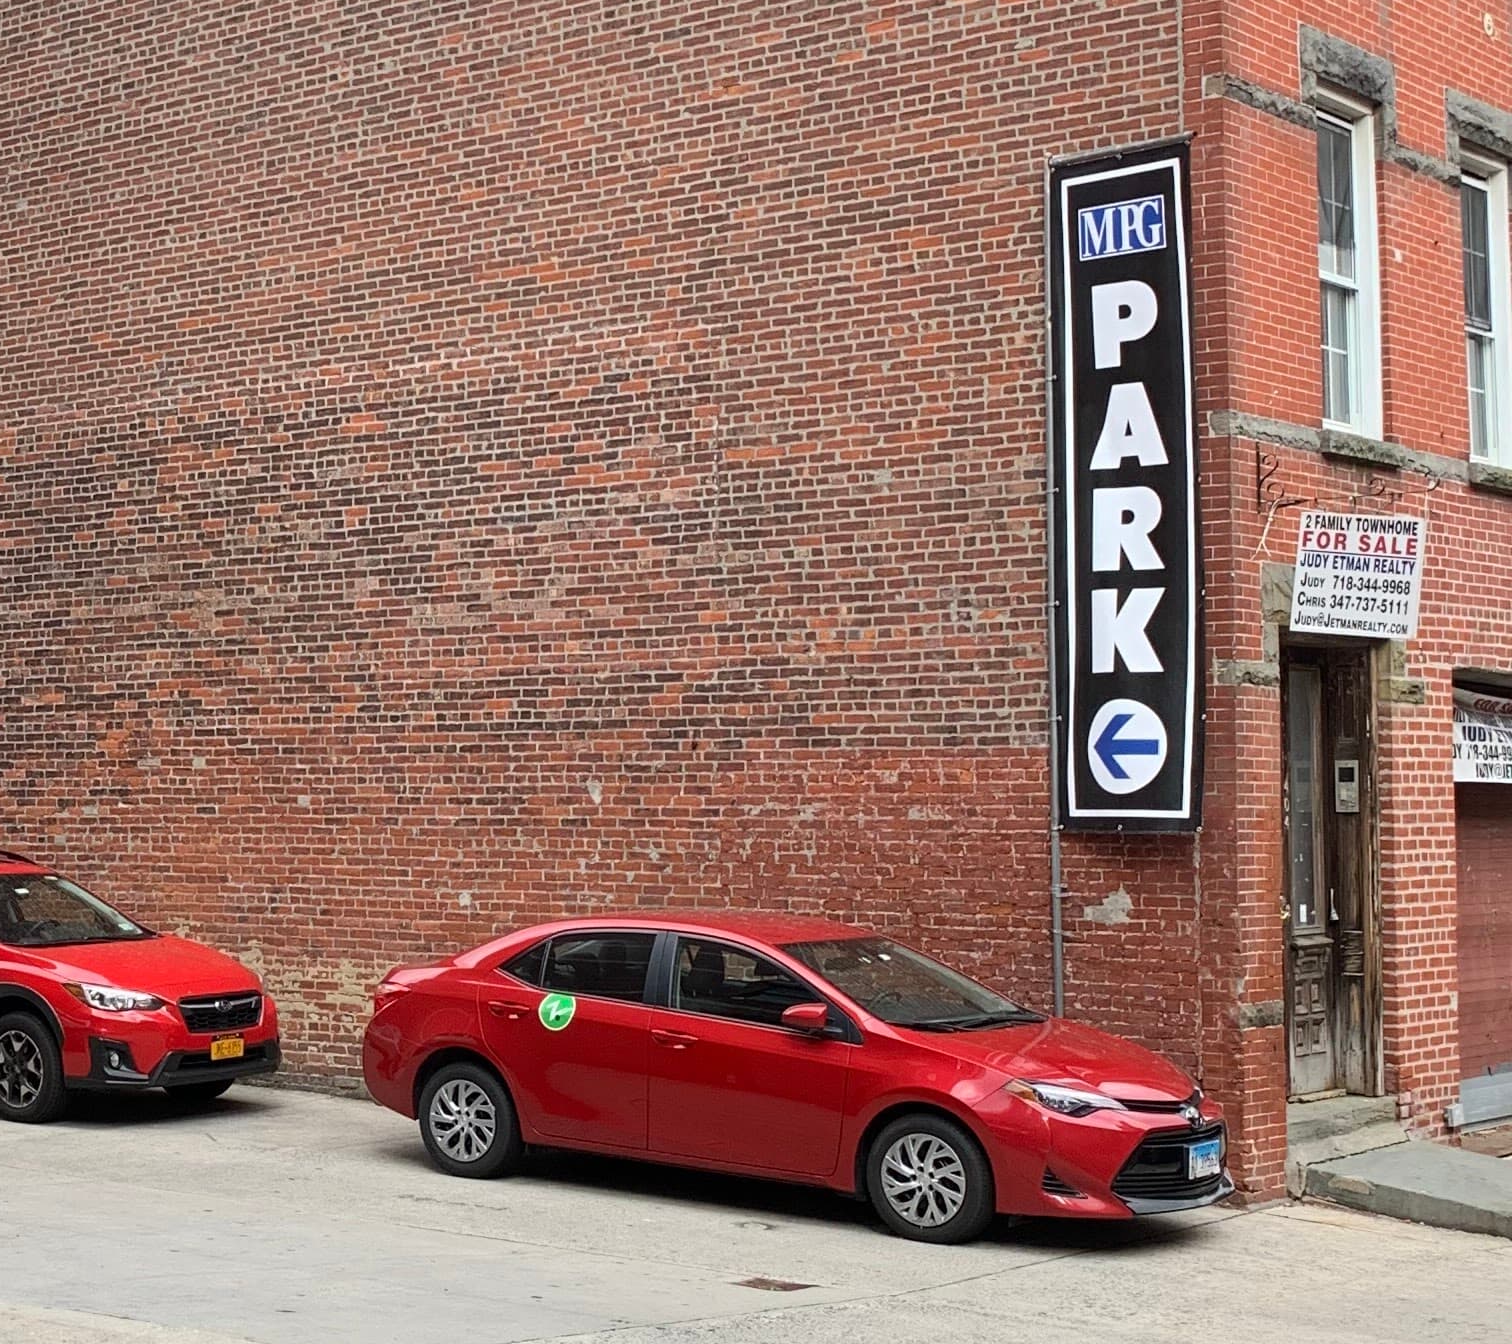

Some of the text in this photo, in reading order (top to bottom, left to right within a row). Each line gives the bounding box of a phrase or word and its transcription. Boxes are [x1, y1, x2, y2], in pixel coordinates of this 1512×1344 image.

[1080, 200, 1165, 260] MPG
[1089, 279, 1170, 674] PARK
[1306, 514, 1419, 537] 2 FAMILY TOWNHOME
[1301, 531, 1419, 556] FOR SALE
[1300, 553, 1416, 576] JUDY ETMAN REALTY
[1332, 574, 1411, 596] 718-344-9968
